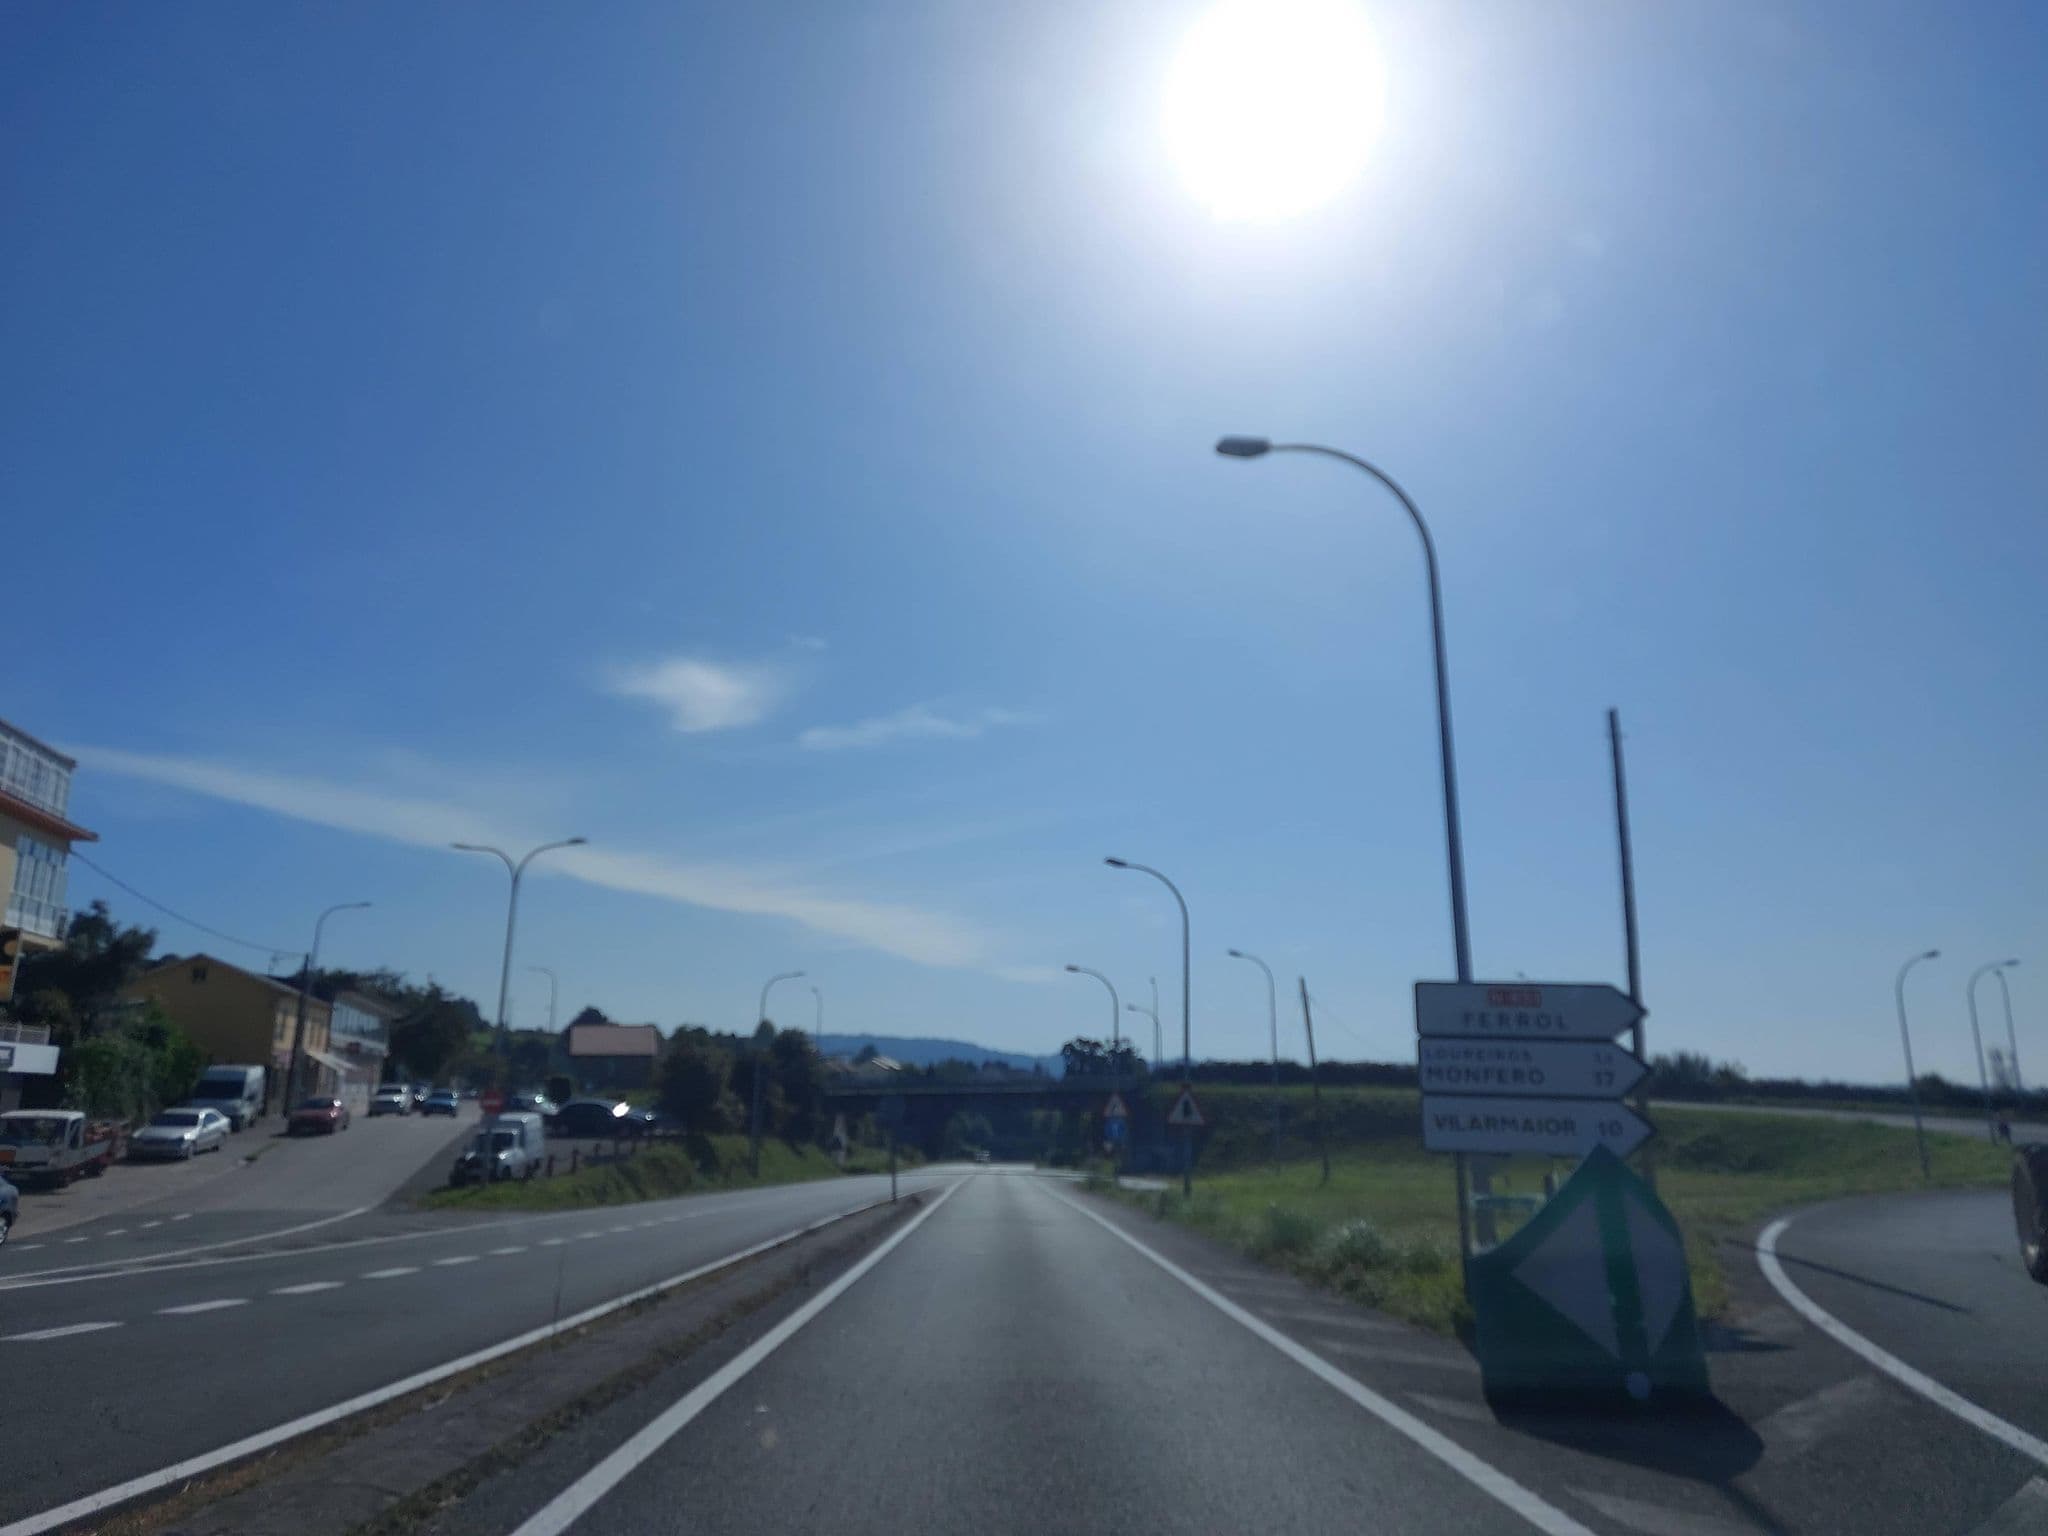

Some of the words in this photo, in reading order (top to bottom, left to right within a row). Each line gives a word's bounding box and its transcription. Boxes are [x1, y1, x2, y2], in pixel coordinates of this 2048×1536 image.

[1463, 1013, 1568, 1031] FERROL
[1426, 1066, 1545, 1085] MONFERO
[1434, 1114, 1576, 1136] VILARMAIOR
[1598, 1120, 1624, 1137] 10
